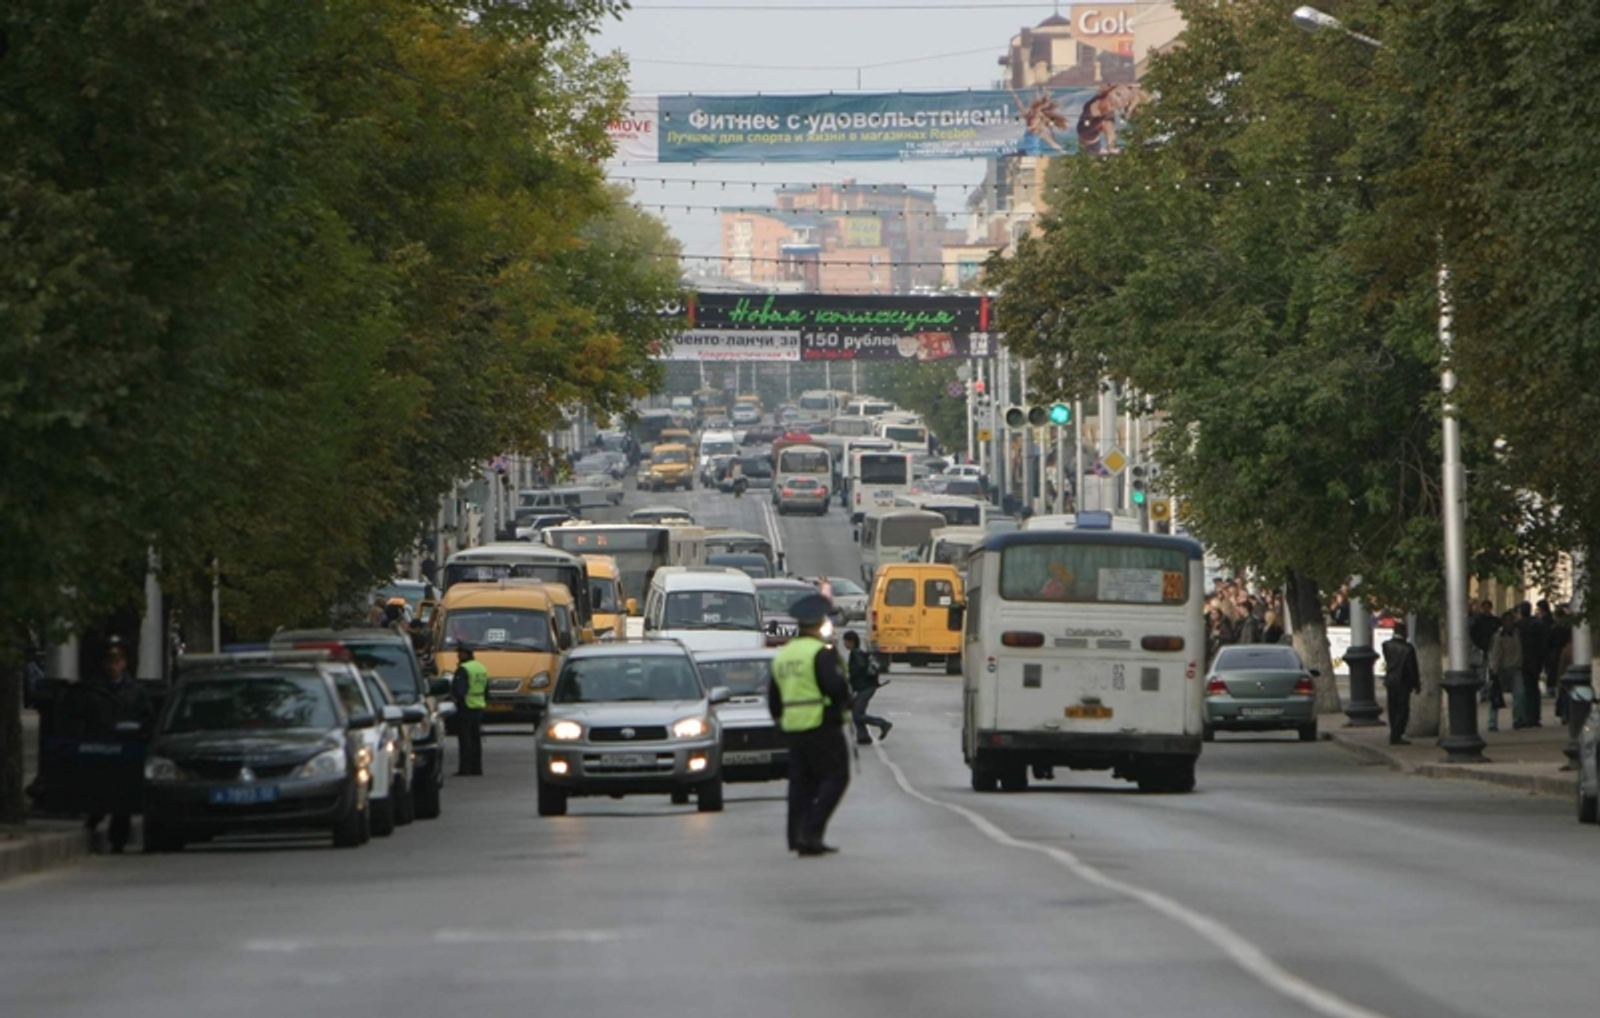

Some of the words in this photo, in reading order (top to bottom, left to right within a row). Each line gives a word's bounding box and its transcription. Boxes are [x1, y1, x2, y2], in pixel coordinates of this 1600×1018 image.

[688, 109, 780, 130] Фитнес
[786, 115, 800, 130] с
[807, 104, 1009, 134] удовольствием!
[666, 130, 716, 145] Лучшее
[718, 132, 744, 145] для
[747, 130, 792, 144] спорта
[794, 132, 804, 142] и
[806, 130, 846, 142] жизни
[849, 131, 857, 141] в
[860, 129, 926, 141] магазинах
[728, 295, 807, 324] Новая
[814, 309, 956, 331] коллекция
[674, 332, 775, 347] бенто-ланчи
[779, 336, 798, 347] за
[804, 332, 839, 347] 150
[843, 333, 901, 349] рублей
